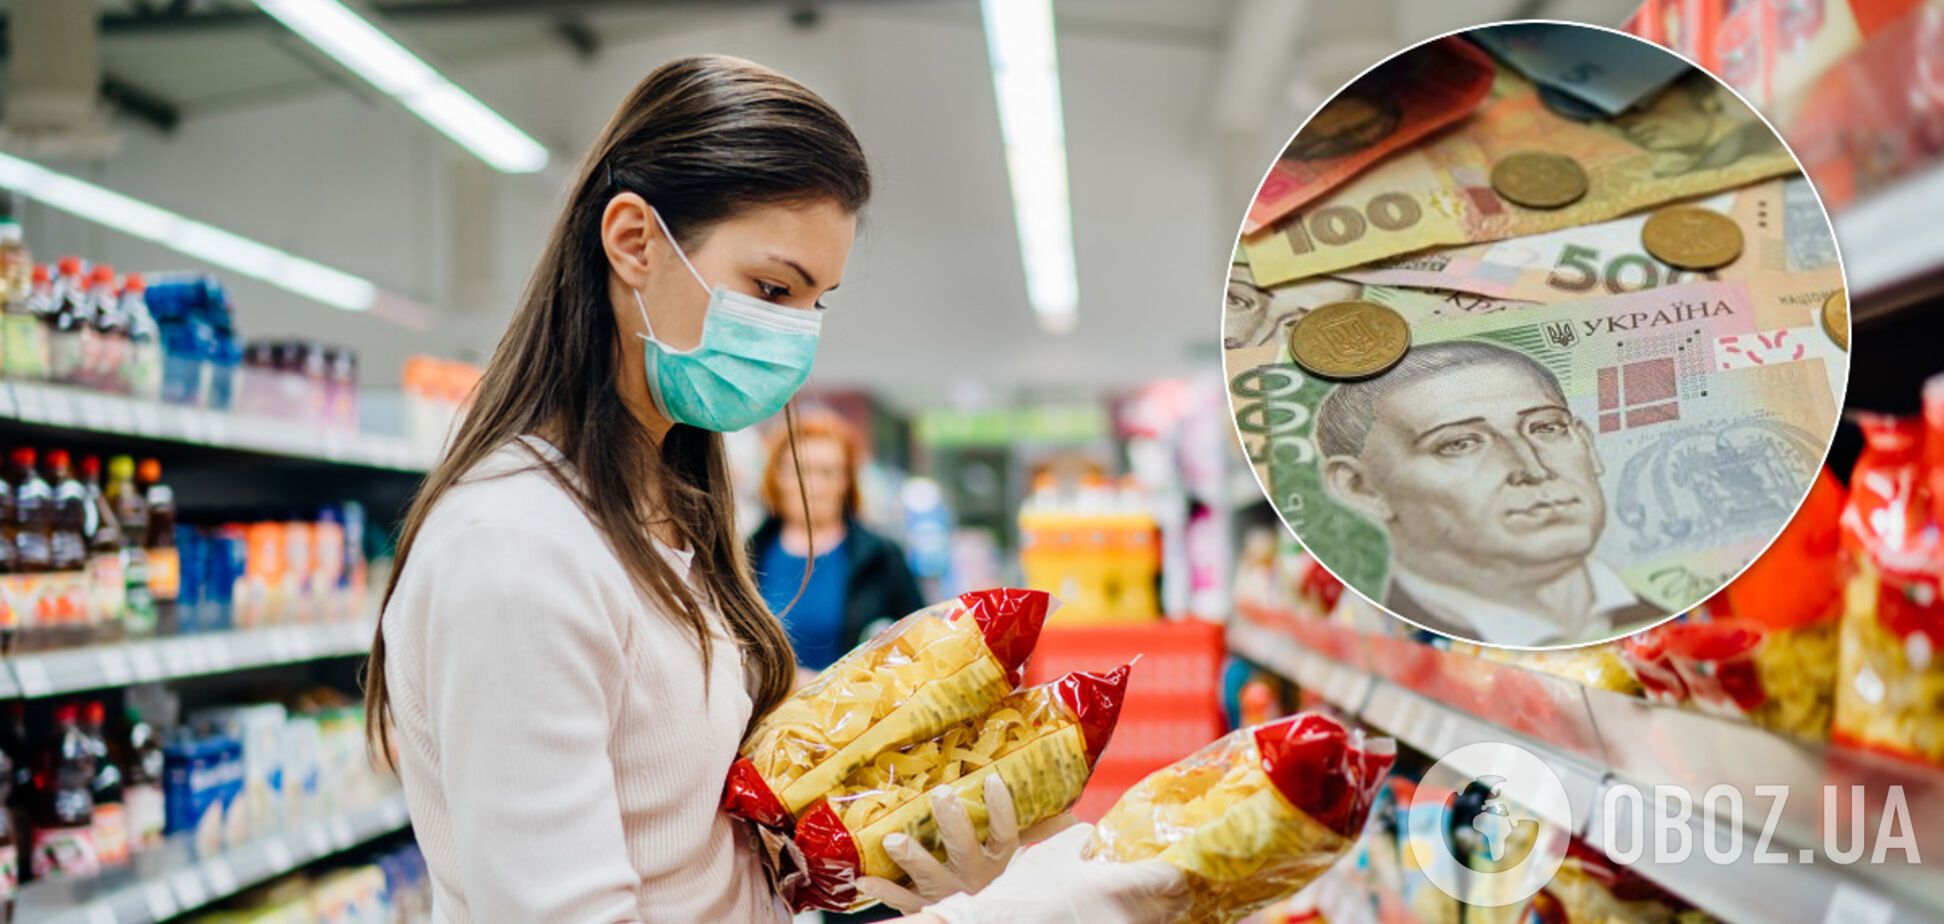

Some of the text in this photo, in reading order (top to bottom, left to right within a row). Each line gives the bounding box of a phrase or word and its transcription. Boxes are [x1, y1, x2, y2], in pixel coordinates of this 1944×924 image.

[1274, 191, 1422, 256] 100
[1546, 243, 1721, 295] 50
[1583, 300, 1735, 337] УКРАЇНА
